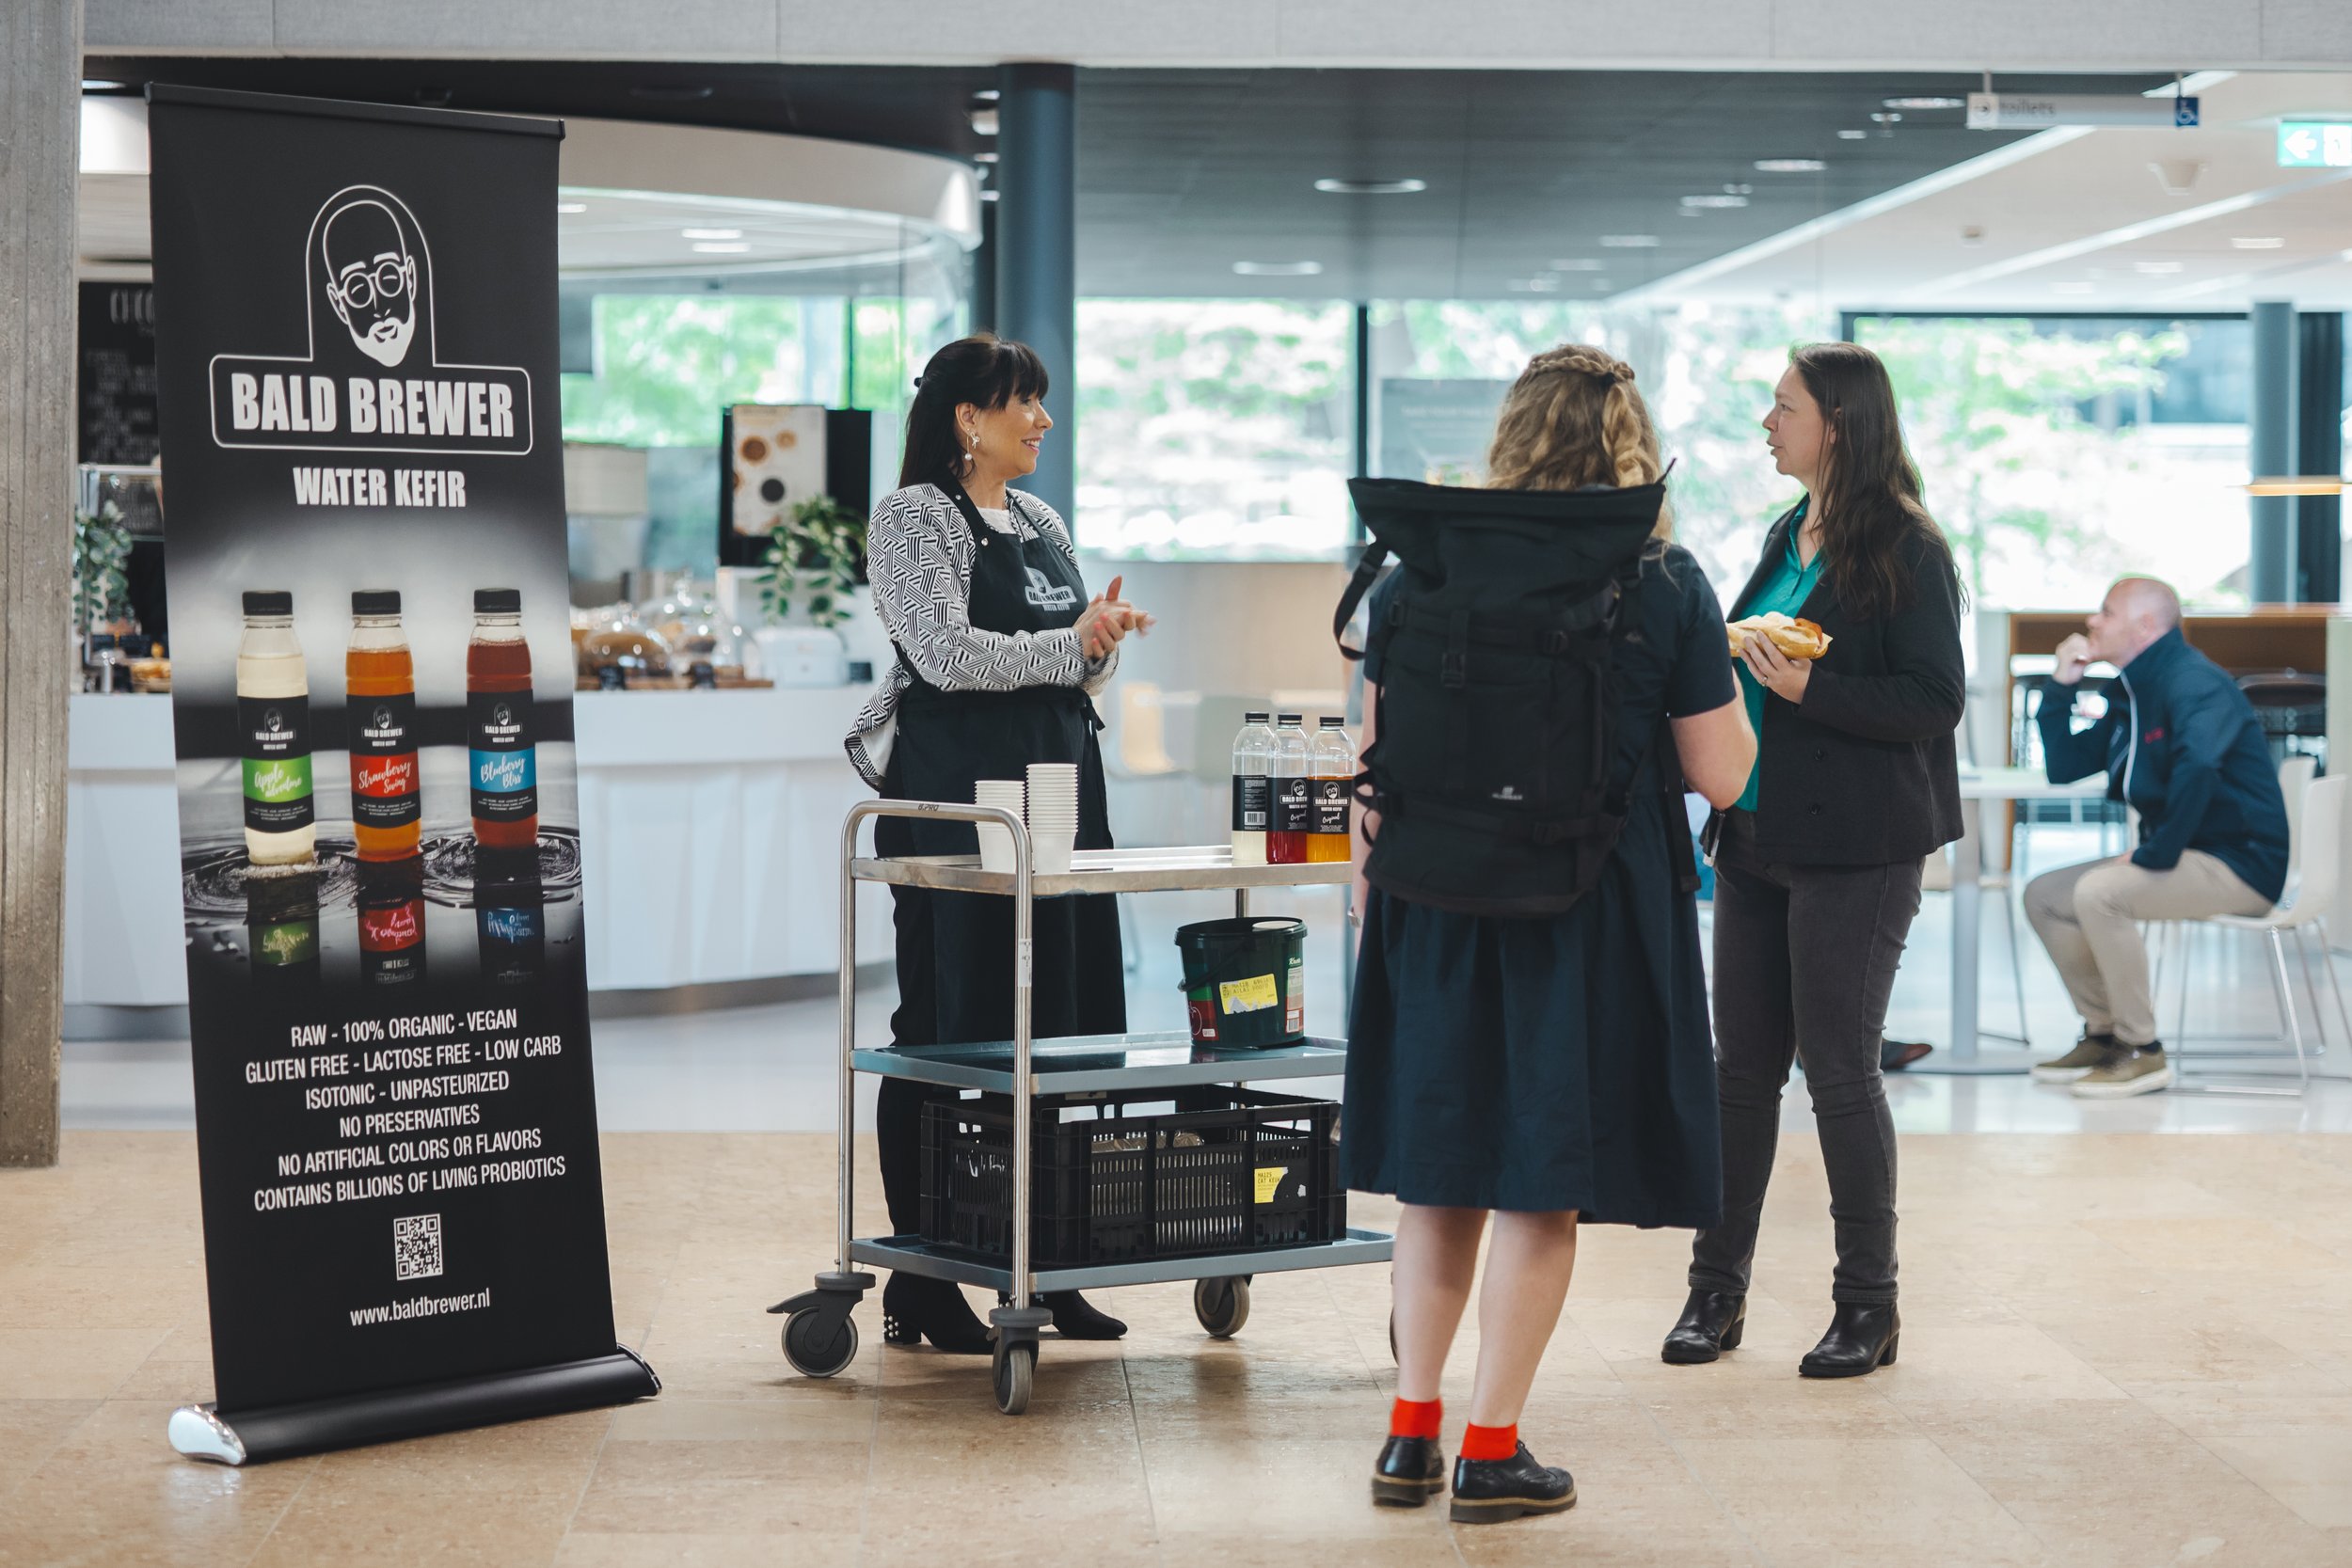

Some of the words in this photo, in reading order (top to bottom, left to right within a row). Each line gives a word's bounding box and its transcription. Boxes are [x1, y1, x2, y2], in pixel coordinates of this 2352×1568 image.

[231, 372, 337, 433] BALD
[348, 377, 515, 437] BREWER
[293, 467, 388, 507] WATER
[394, 468, 466, 508] KEFIR
[358, 758, 412, 789] Strawberry
[383, 778, 405, 794] Swing
[480, 753, 526, 784] Blueberry
[502, 770, 523, 789] Bliss
[291, 1024, 326, 1048] RAW
[342, 1020, 384, 1043] 100%
[389, 1014, 454, 1038] ORGANIC
[467, 1008, 517, 1033] VEGAN
[246, 1058, 306, 1084] GLUTEN
[310, 1053, 349, 1078] FREE
[364, 1047, 433, 1072] LACTOSE
[437, 1043, 470, 1066] FREE
[485, 1038, 519, 1061] LOW
[524, 1036, 562, 1057] CARB
[306, 1084, 374, 1110] ISOTONIC
[390, 1070, 509, 1101] UNPASTEURIZED
[340, 1116, 360, 1137] NO
[365, 1103, 480, 1134] PRESERVATIVES
[278, 1154, 301, 1177] NO
[305, 1146, 385, 1174] ARTIFICIAL
[389, 1138, 450, 1164] COLORS
[453, 1135, 472, 1157] OR
[476, 1129, 542, 1154] FLAVORS
[254, 1183, 332, 1212] CONTAINS
[337, 1175, 404, 1202] BILLIONS
[408, 1172, 427, 1194] OF
[433, 1166, 477, 1191] LIVING
[481, 1156, 565, 1184] PROBIOTICS
[350, 1288, 490, 1326] www.baldbrewer.nl
